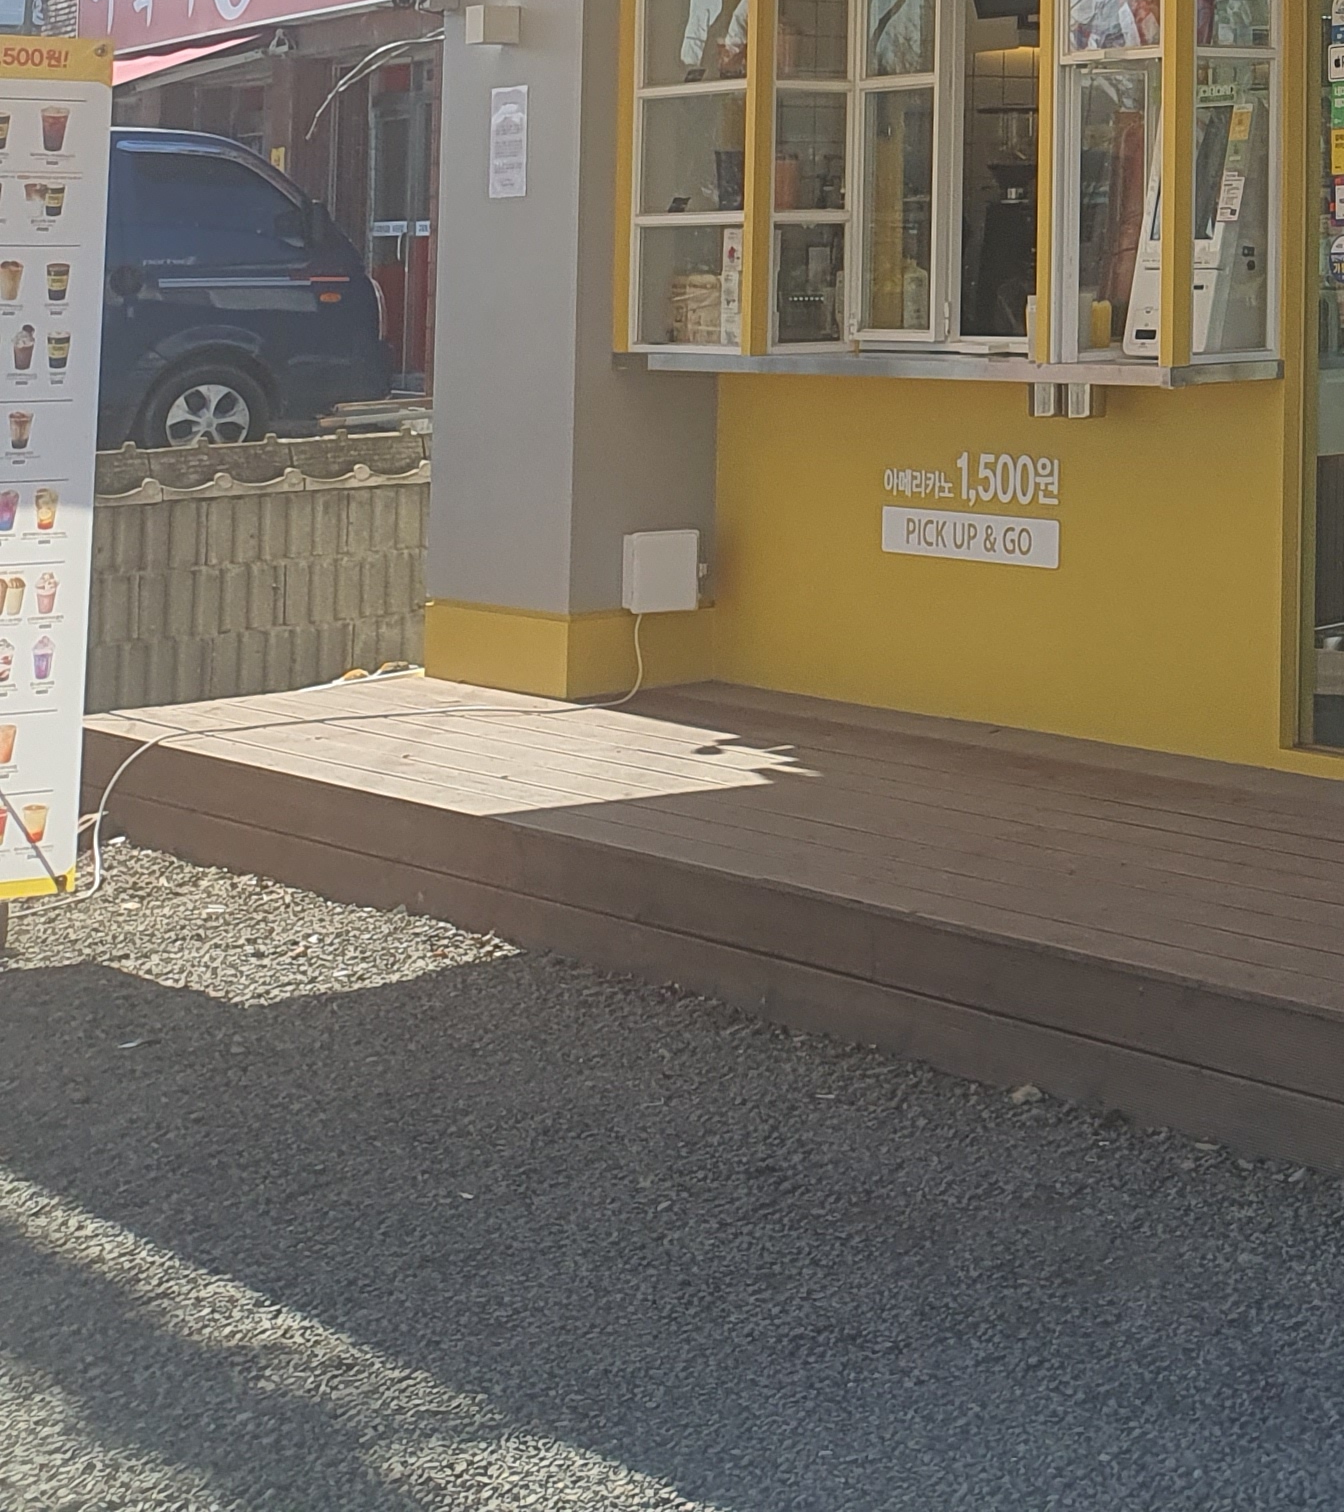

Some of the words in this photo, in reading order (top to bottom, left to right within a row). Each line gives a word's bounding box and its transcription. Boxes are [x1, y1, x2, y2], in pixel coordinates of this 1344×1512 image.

[0, 47, 69, 68] 500원!
[884, 468, 954, 499] 아메리카노
[957, 452, 1059, 506] 1,500원
[906, 517, 947, 548] PICK
[953, 522, 978, 551] UP
[983, 524, 997, 553] &
[1003, 526, 1032, 556] GO
